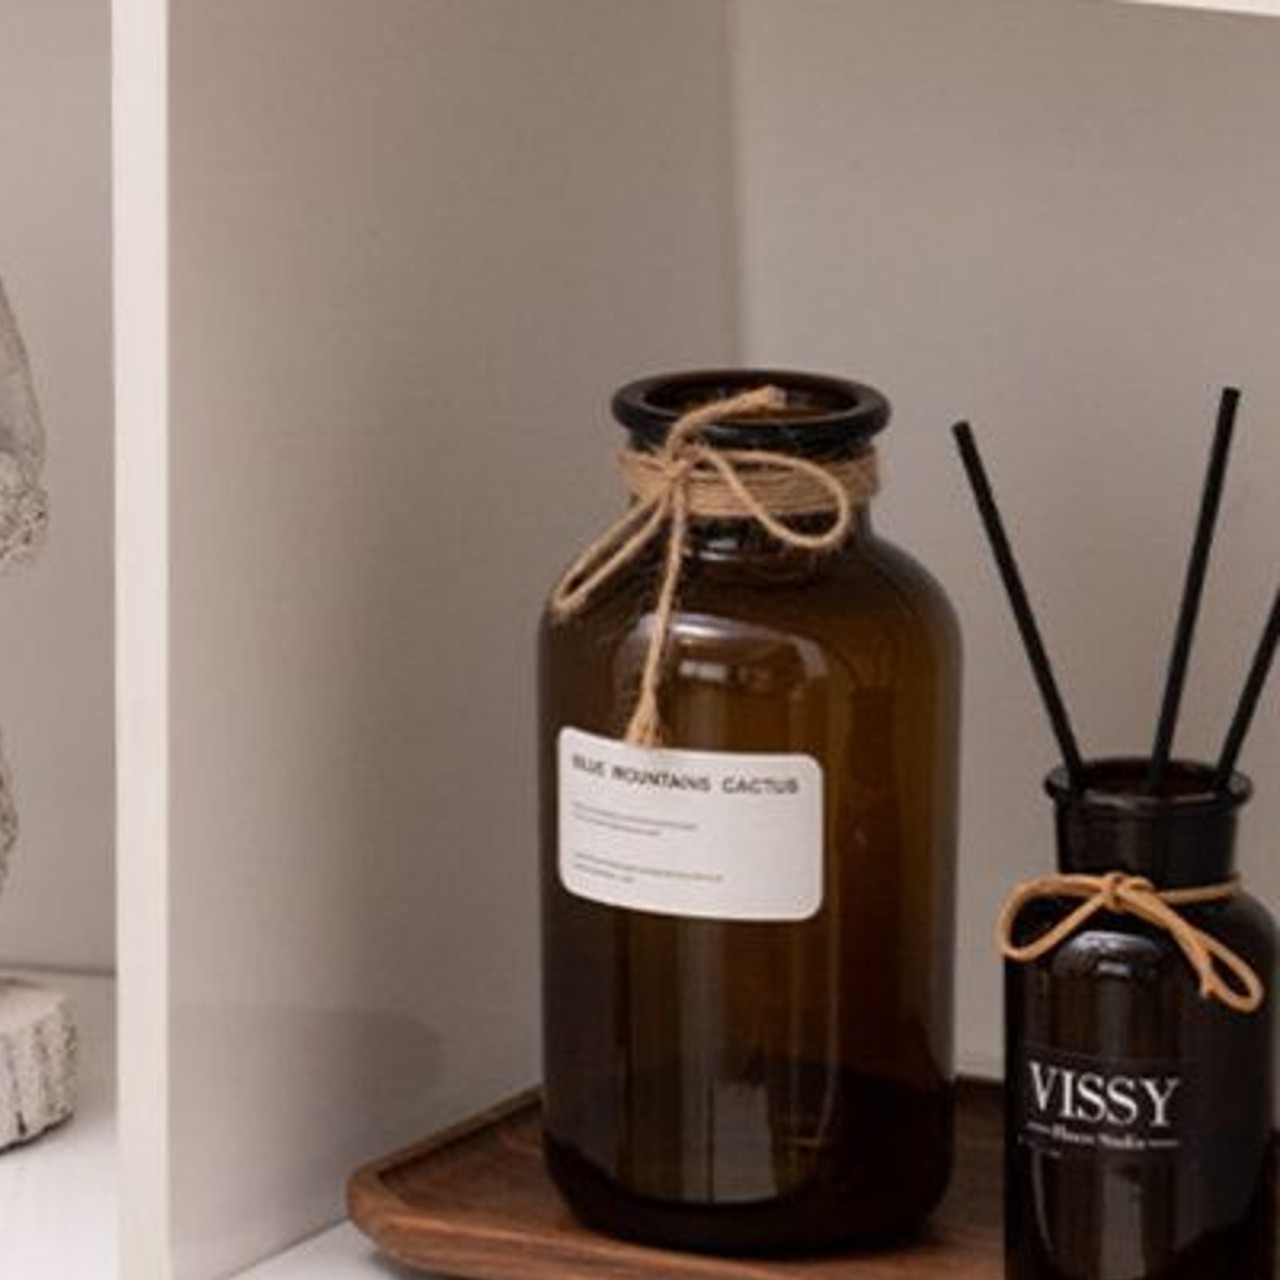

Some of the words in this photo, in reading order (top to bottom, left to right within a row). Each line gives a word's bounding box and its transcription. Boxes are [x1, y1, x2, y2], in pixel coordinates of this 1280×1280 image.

[571, 755, 606, 777] BLUE
[611, 765, 712, 793] MOUNTAINS
[721, 778, 799, 795] CACTUS
[1029, 1059, 1181, 1128] VISSY
